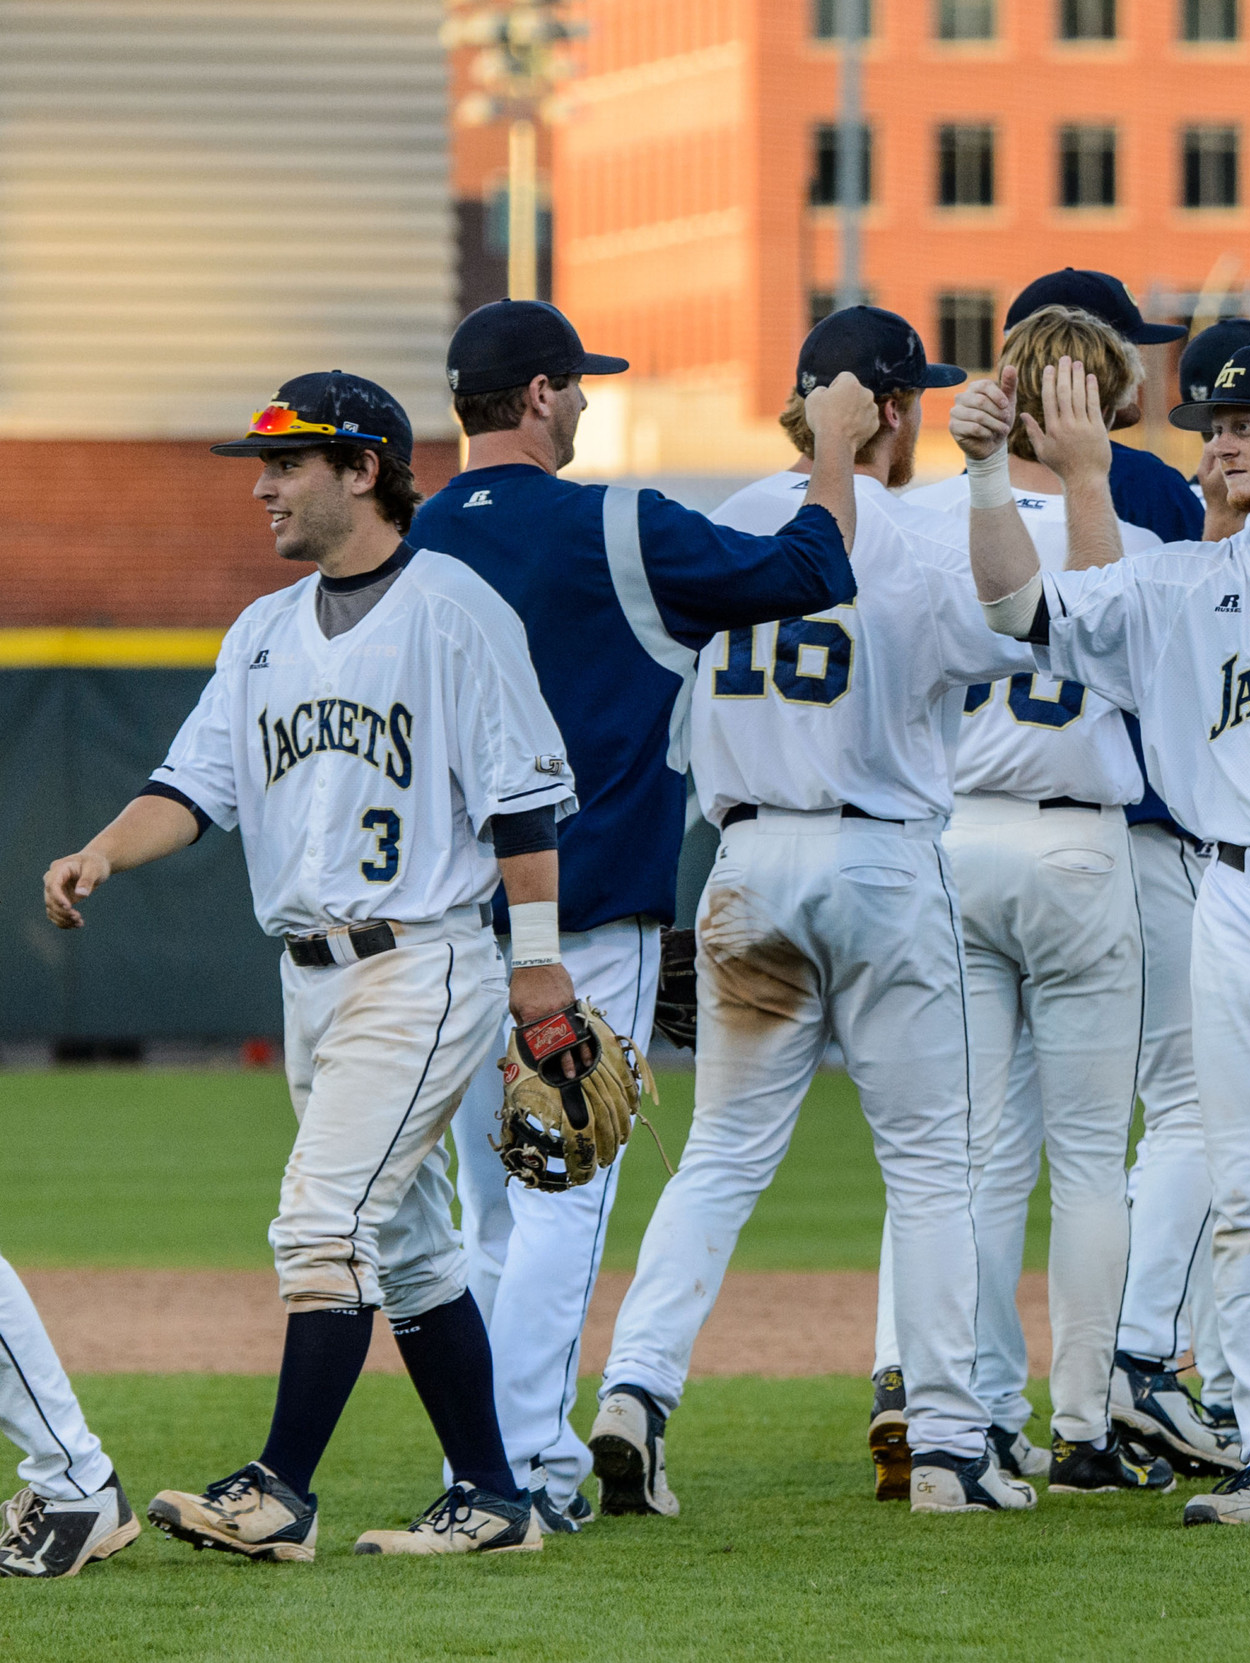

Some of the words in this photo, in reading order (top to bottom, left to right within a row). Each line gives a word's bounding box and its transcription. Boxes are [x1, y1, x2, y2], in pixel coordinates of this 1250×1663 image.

[711, 595, 856, 709] 16
[258, 697, 413, 795] JACKETS
[359, 806, 403, 885] 3
